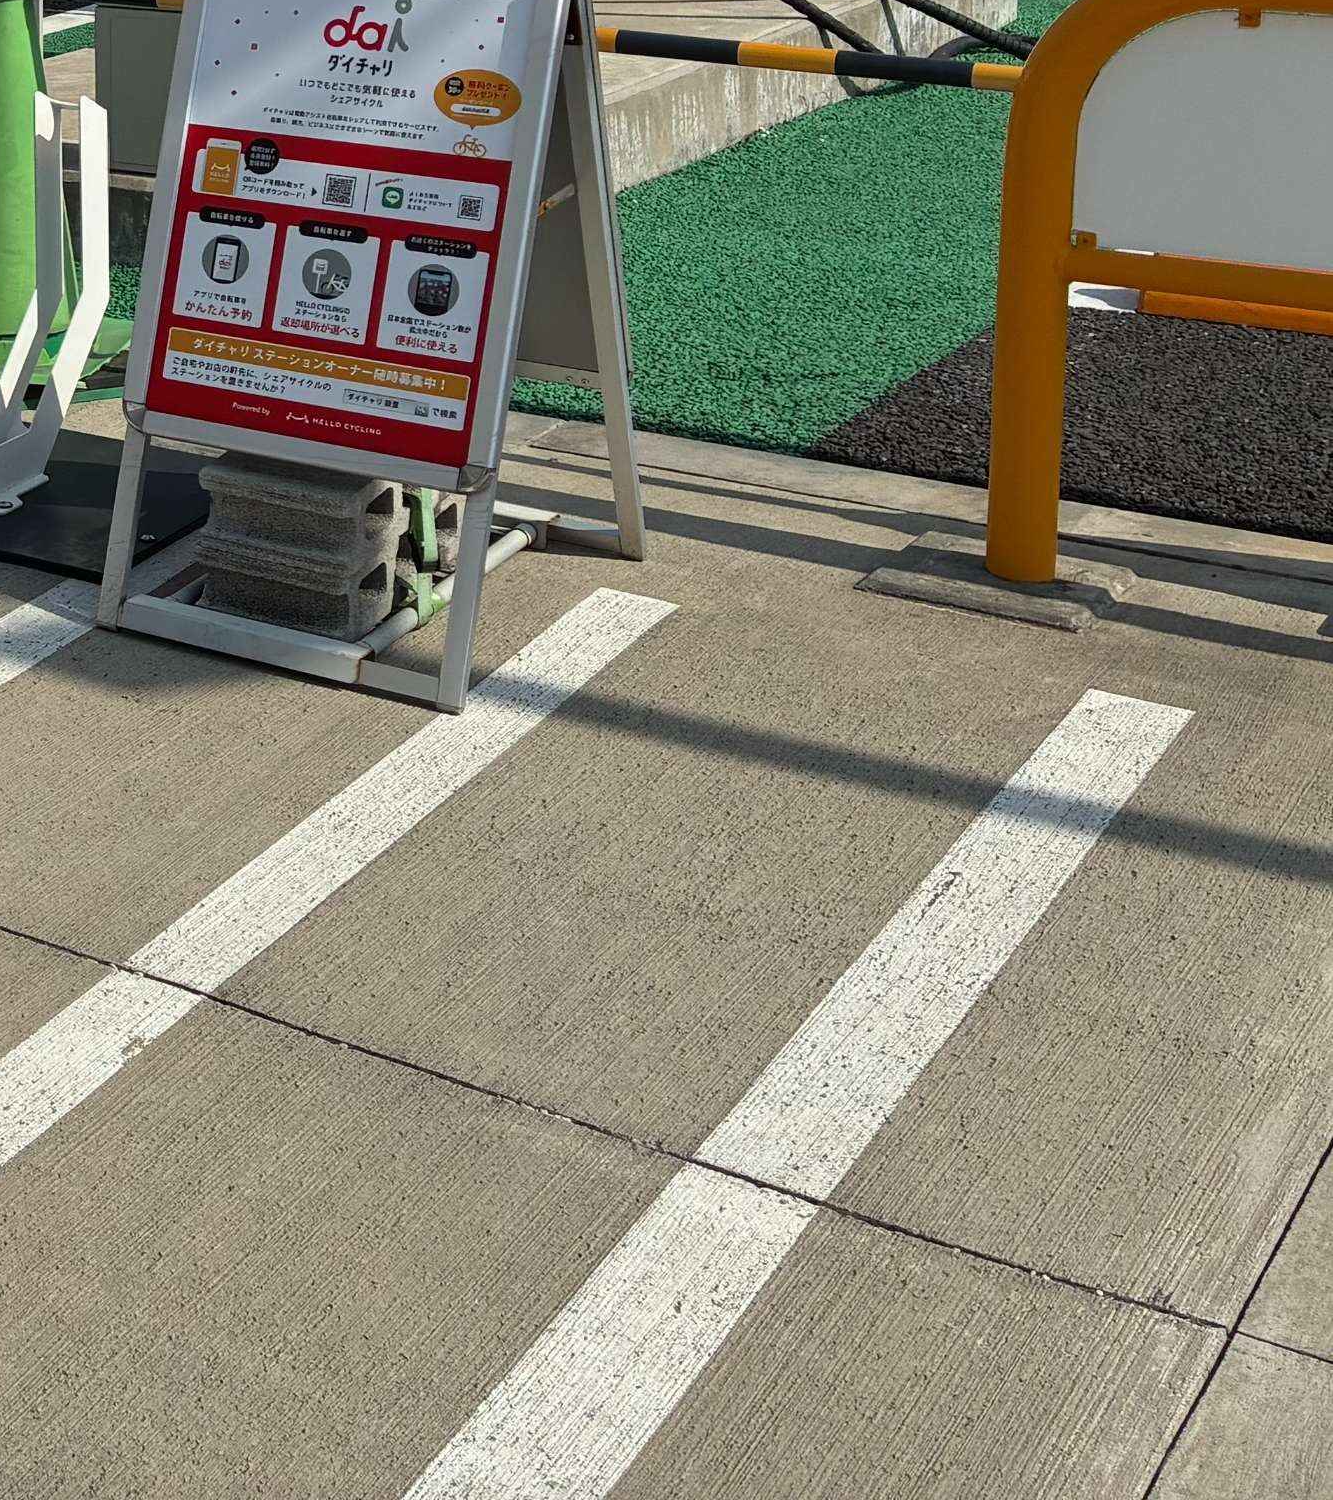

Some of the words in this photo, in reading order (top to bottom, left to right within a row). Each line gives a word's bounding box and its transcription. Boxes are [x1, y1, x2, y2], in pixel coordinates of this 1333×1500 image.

[327, 54, 394, 77] ダイチャリ
[299, 78, 416, 99] いつでもどこでも気軽に使える
[330, 94, 384, 109] シェアサイクル
[184, 300, 253, 322] かんたん予約
[280, 316, 360, 339] 返却場所が選べる
[395, 335, 458, 355] 便利に使える
[232, 402, 261, 414] Powered
[261, 408, 271, 416] by
[312, 416, 342, 429] HELLO
[344, 421, 382, 436] CYCLING
